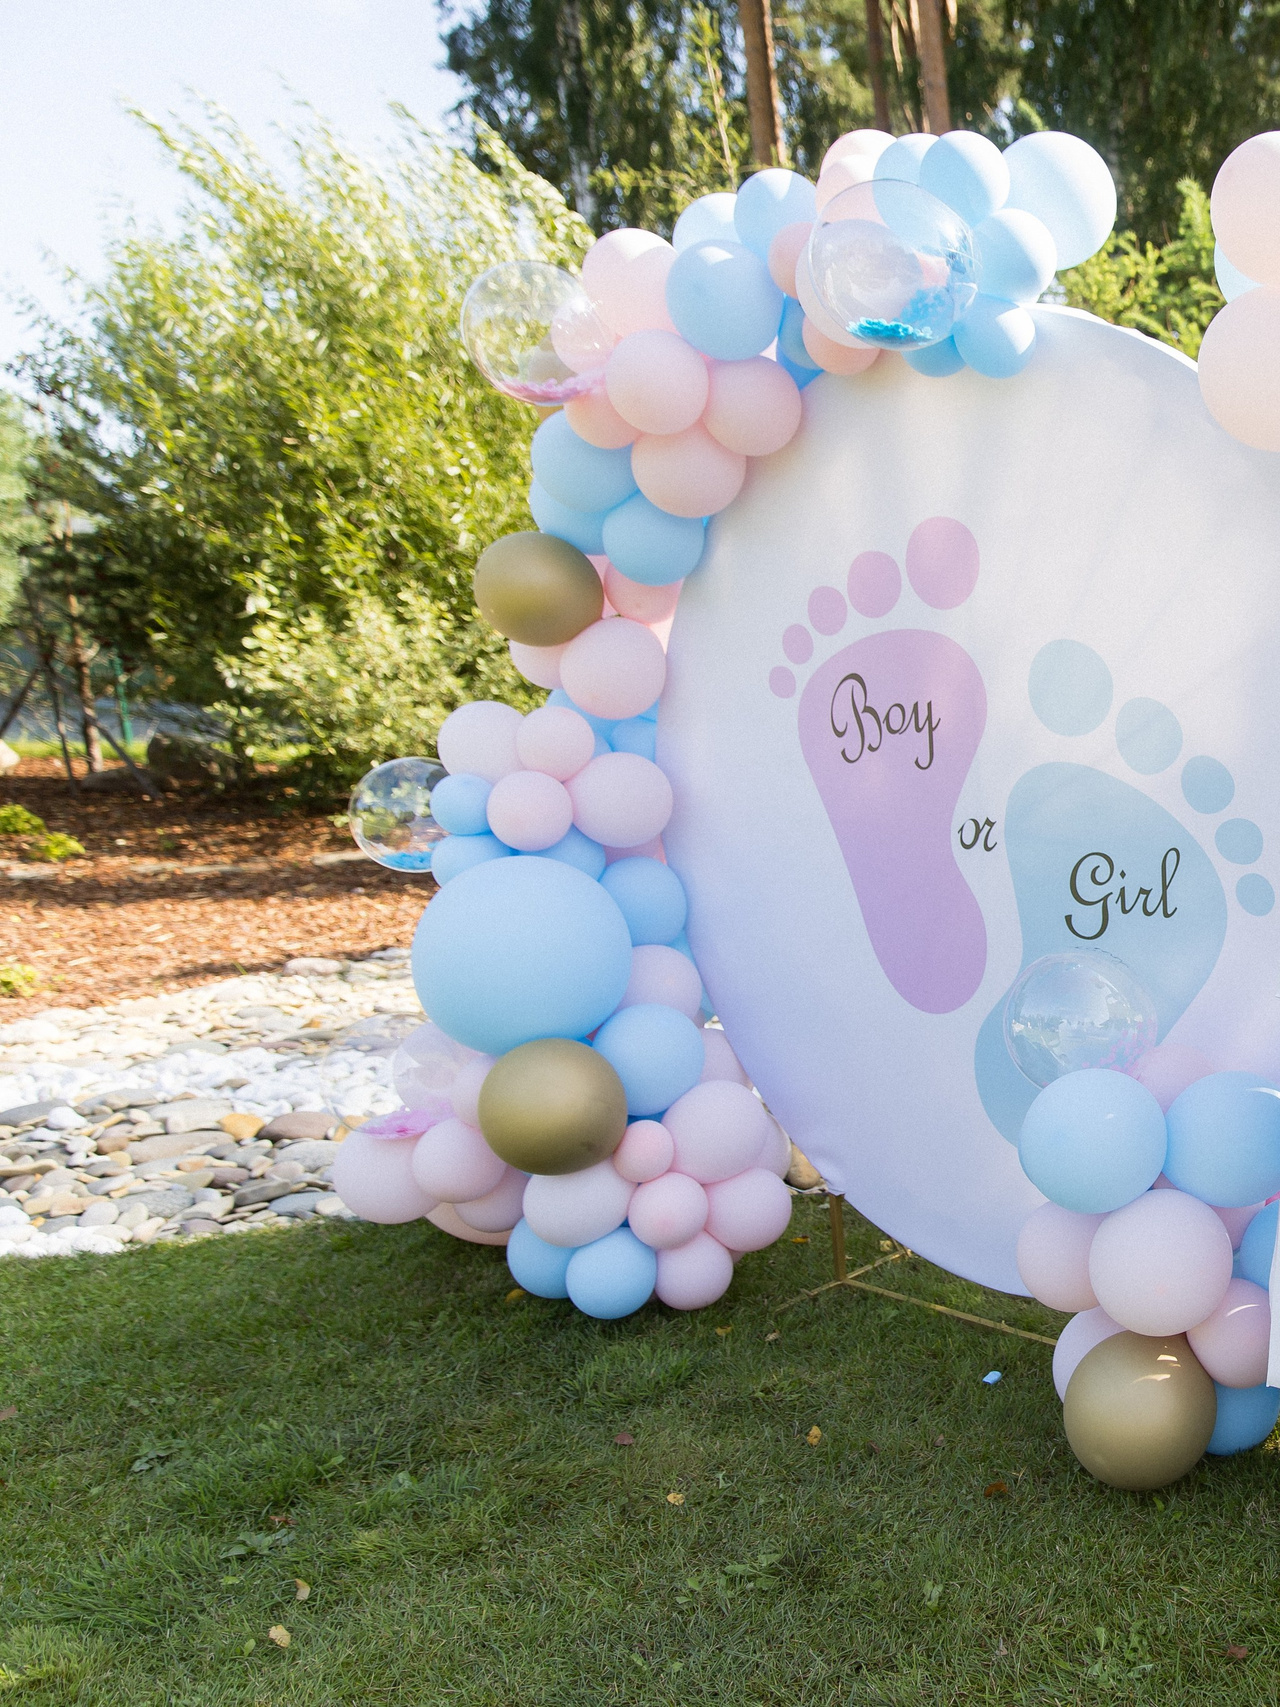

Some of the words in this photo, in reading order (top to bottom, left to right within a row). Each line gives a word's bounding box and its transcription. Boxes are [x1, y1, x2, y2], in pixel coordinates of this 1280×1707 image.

[830, 672, 941, 770] Boy
[957, 816, 998, 852] or
[1064, 847, 1181, 940] Girl
